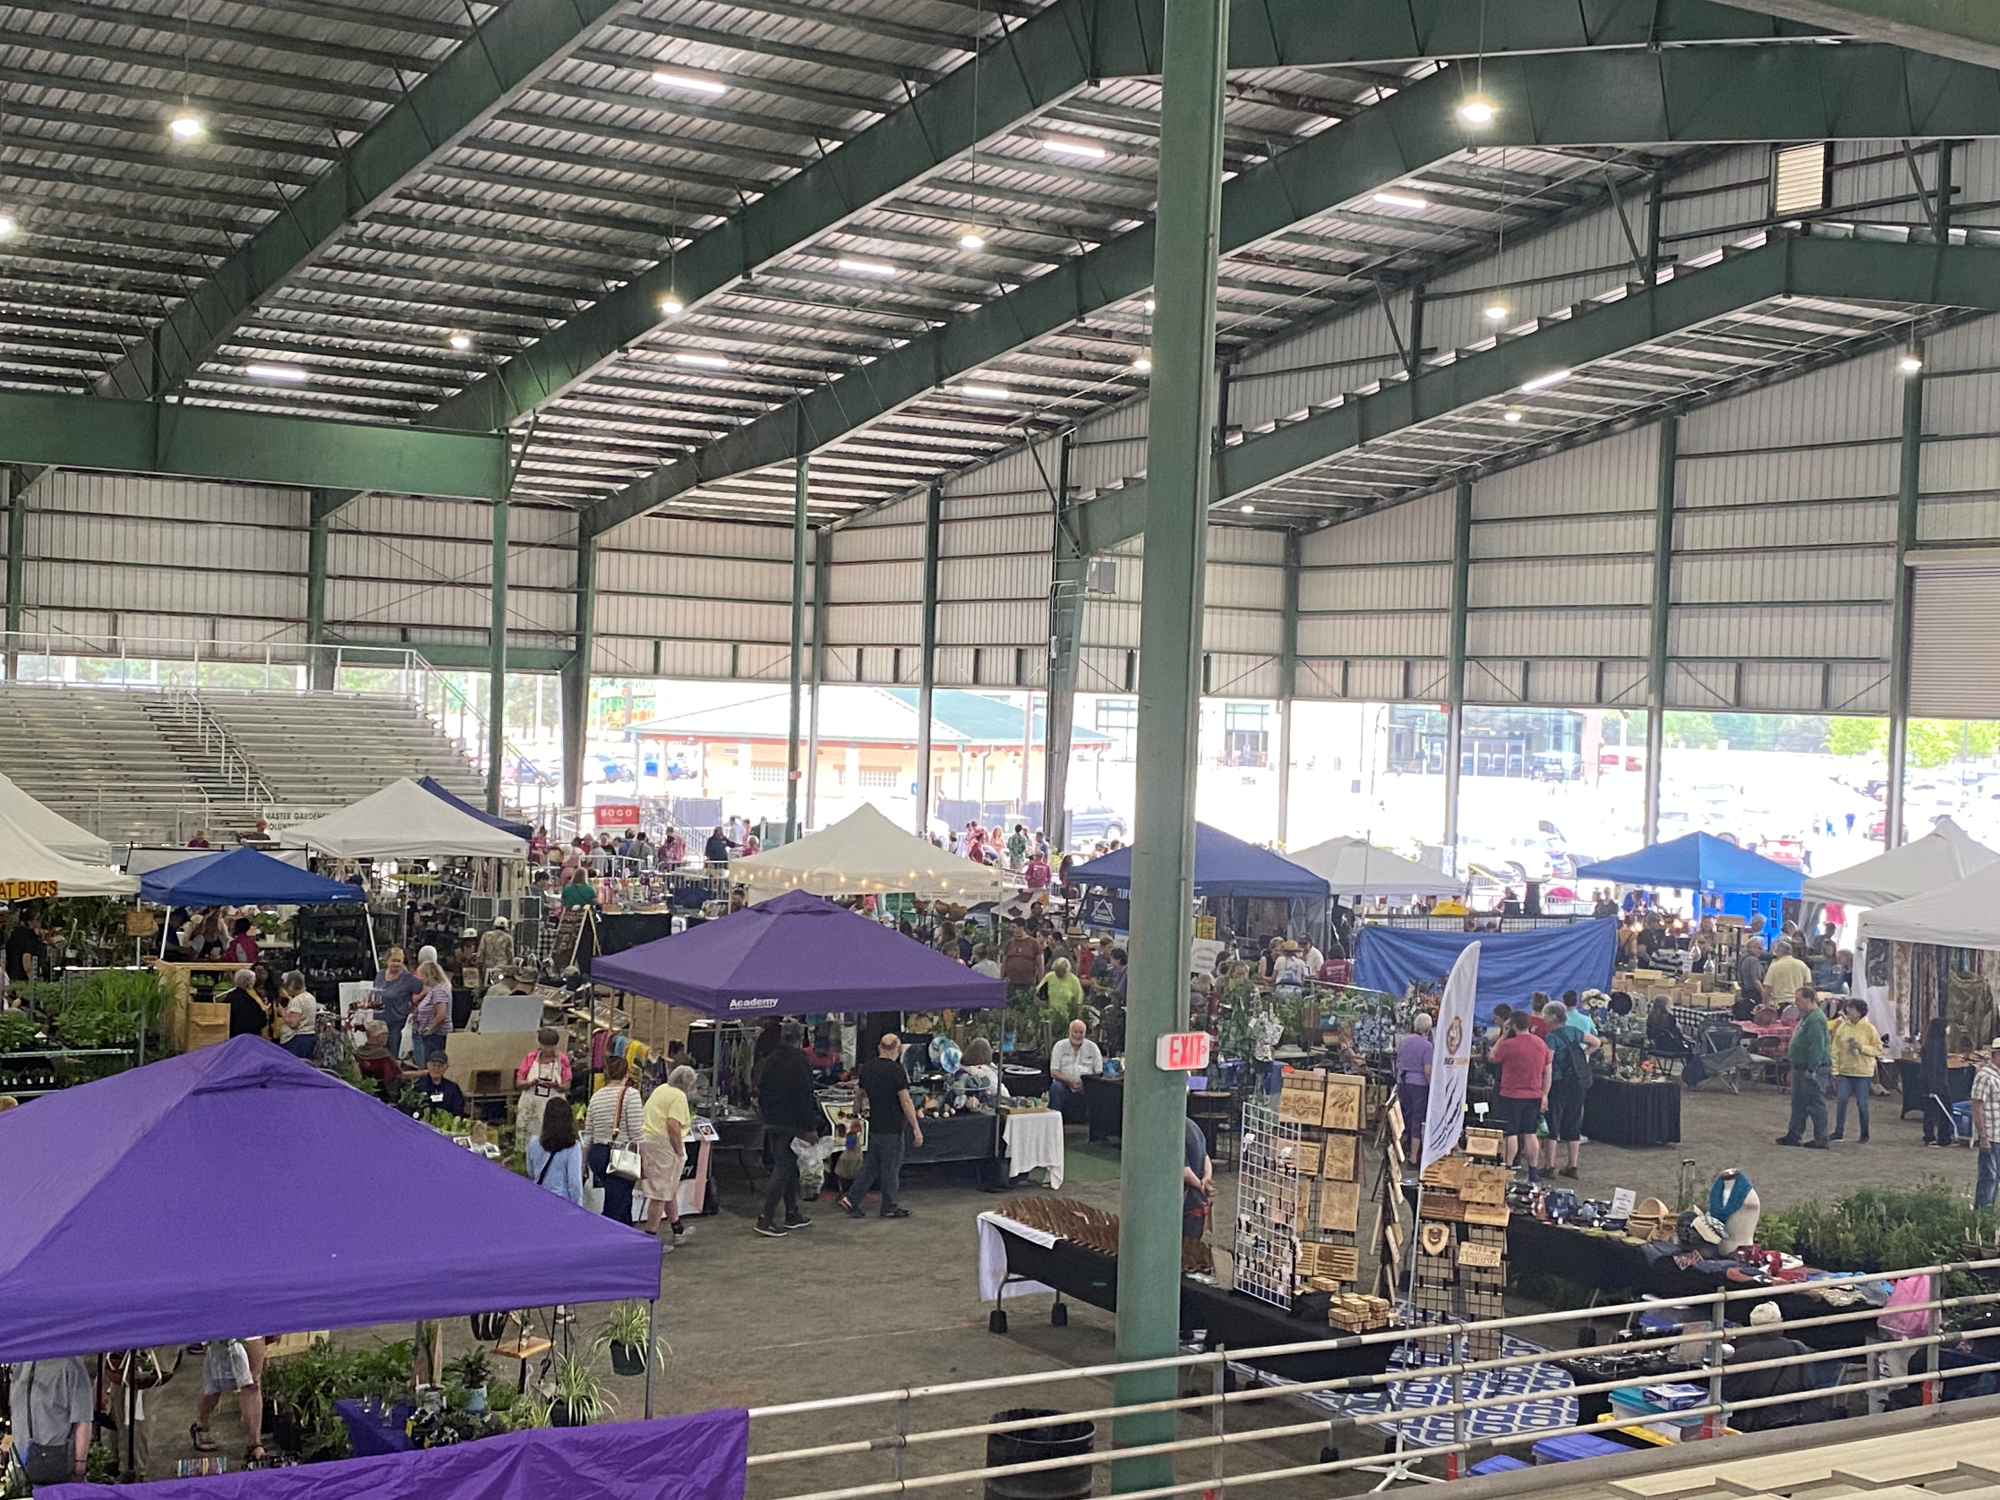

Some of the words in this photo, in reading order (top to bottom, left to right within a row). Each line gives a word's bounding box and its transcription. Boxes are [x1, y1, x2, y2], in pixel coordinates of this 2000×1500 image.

[265, 812, 291, 820] MASTER
[18, 880, 58, 898] BUGS
[729, 998, 778, 1008] Academy
[1169, 1034, 1205, 1067] EXIT
